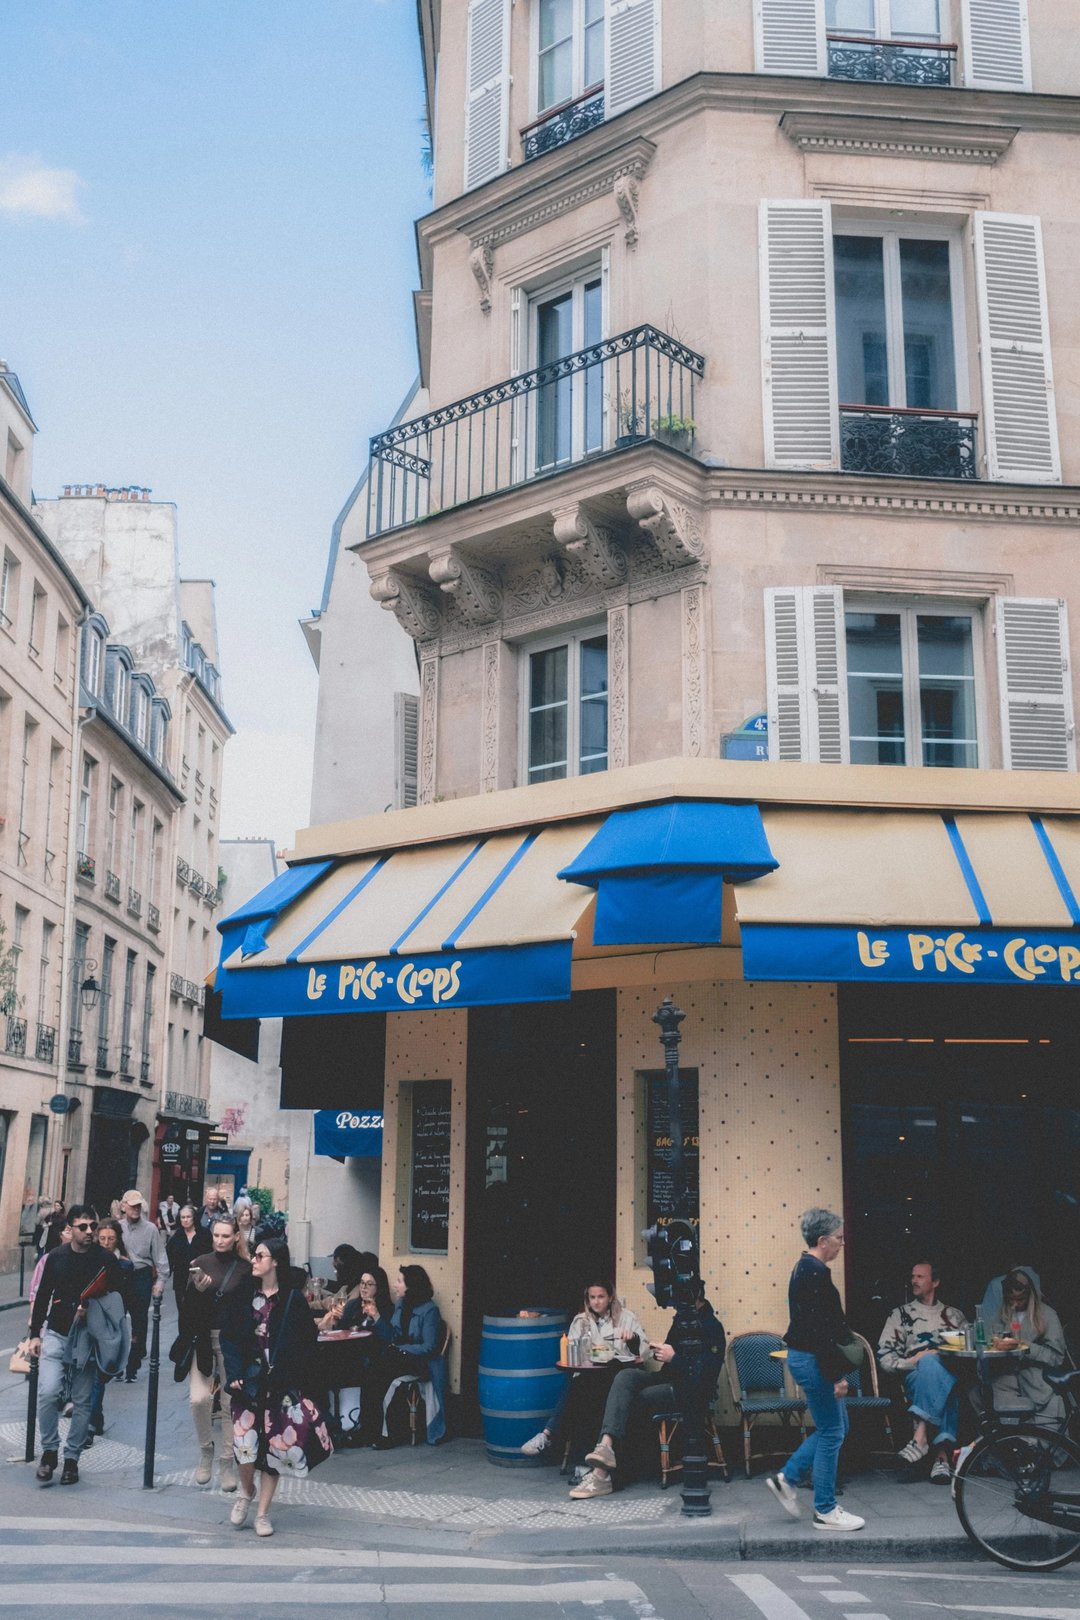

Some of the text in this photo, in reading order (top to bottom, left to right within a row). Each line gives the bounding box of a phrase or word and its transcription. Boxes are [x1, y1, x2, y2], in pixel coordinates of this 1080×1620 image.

[857, 931, 1080, 982] LE PiCK-CLOP
[307, 967, 327, 1000] LE
